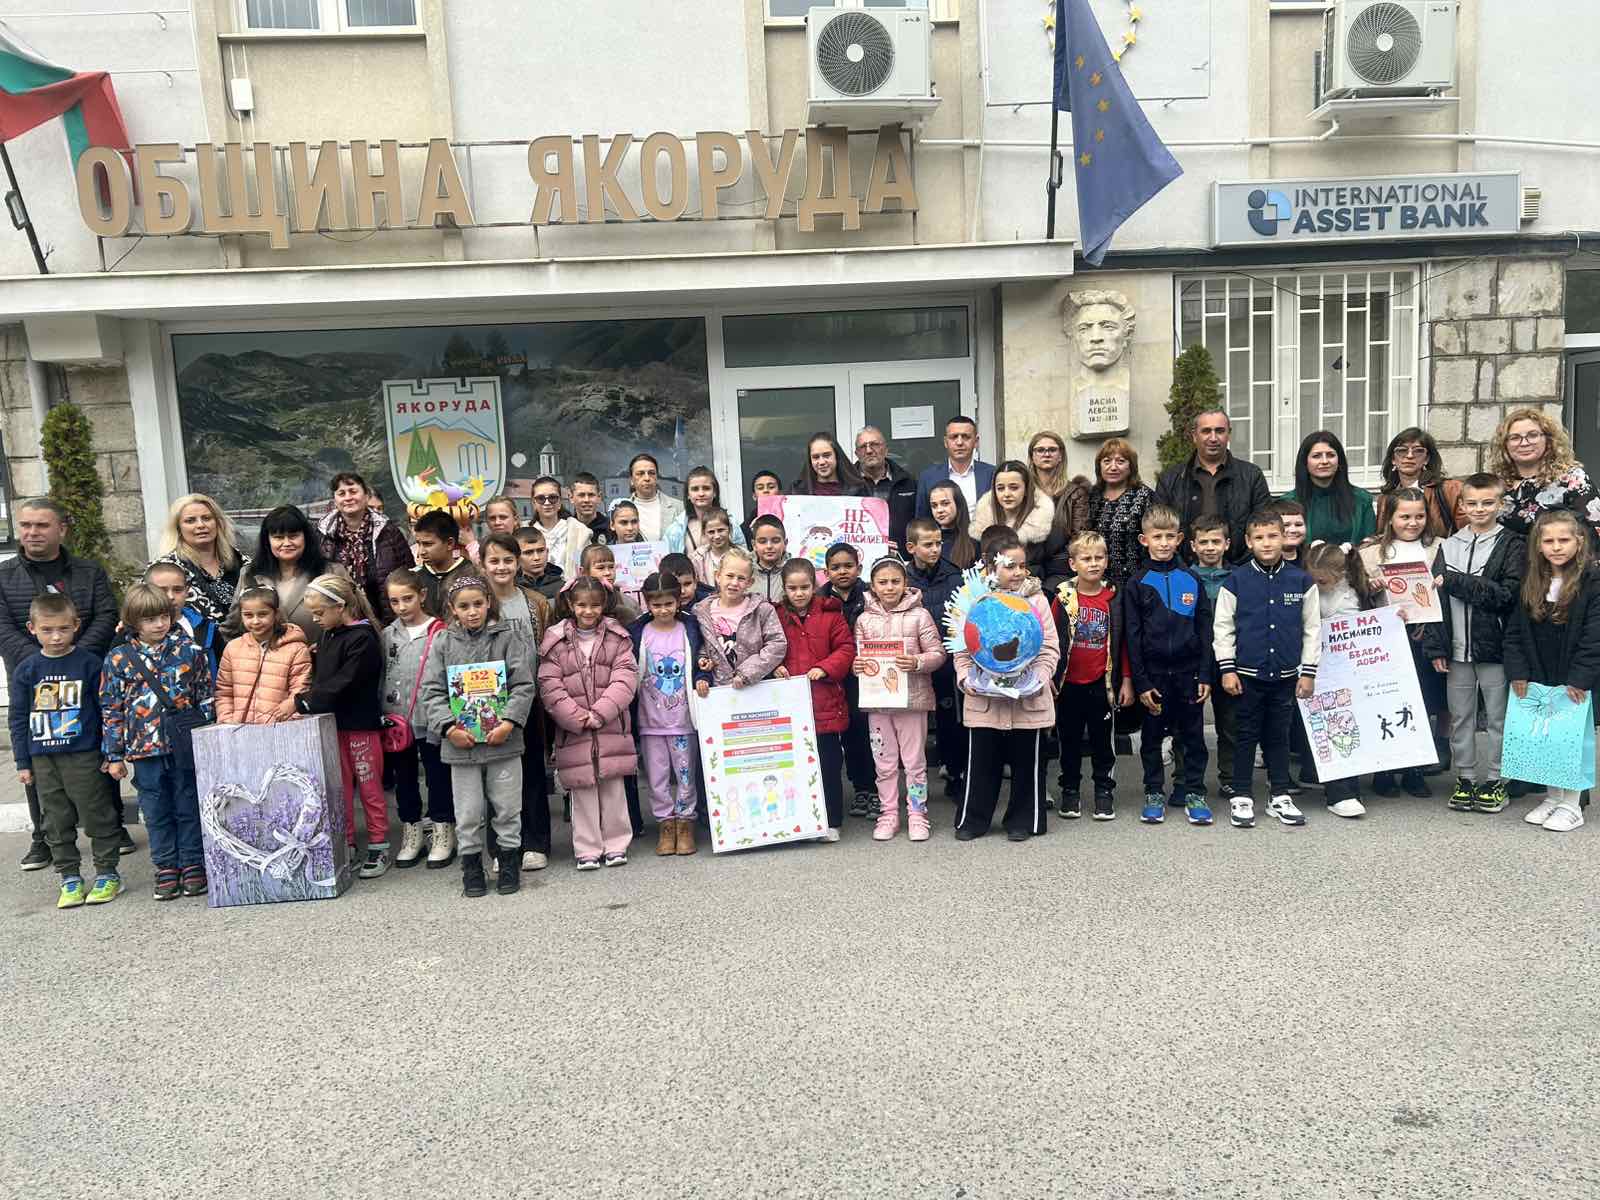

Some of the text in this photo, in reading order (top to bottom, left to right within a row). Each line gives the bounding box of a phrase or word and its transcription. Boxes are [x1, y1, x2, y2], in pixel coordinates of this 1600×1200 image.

[76, 124, 920, 249] ОБЩИНА ЯКОРУДА
[1295, 182, 1488, 207] INTERNATIONAL
[1292, 203, 1490, 234] ASSET BANK
[396, 399, 491, 414] ЯКОРУДА
[845, 509, 869, 522] НЕ
[844, 522, 865, 533] НА
[1331, 615, 1379, 632] НЕ НА
[1329, 626, 1382, 643] НАСИЛИЕТО
[1330, 641, 1356, 653] НЕКА
[1356, 652, 1390, 667] ДОБРИ!
[471, 671, 489, 681] 52
